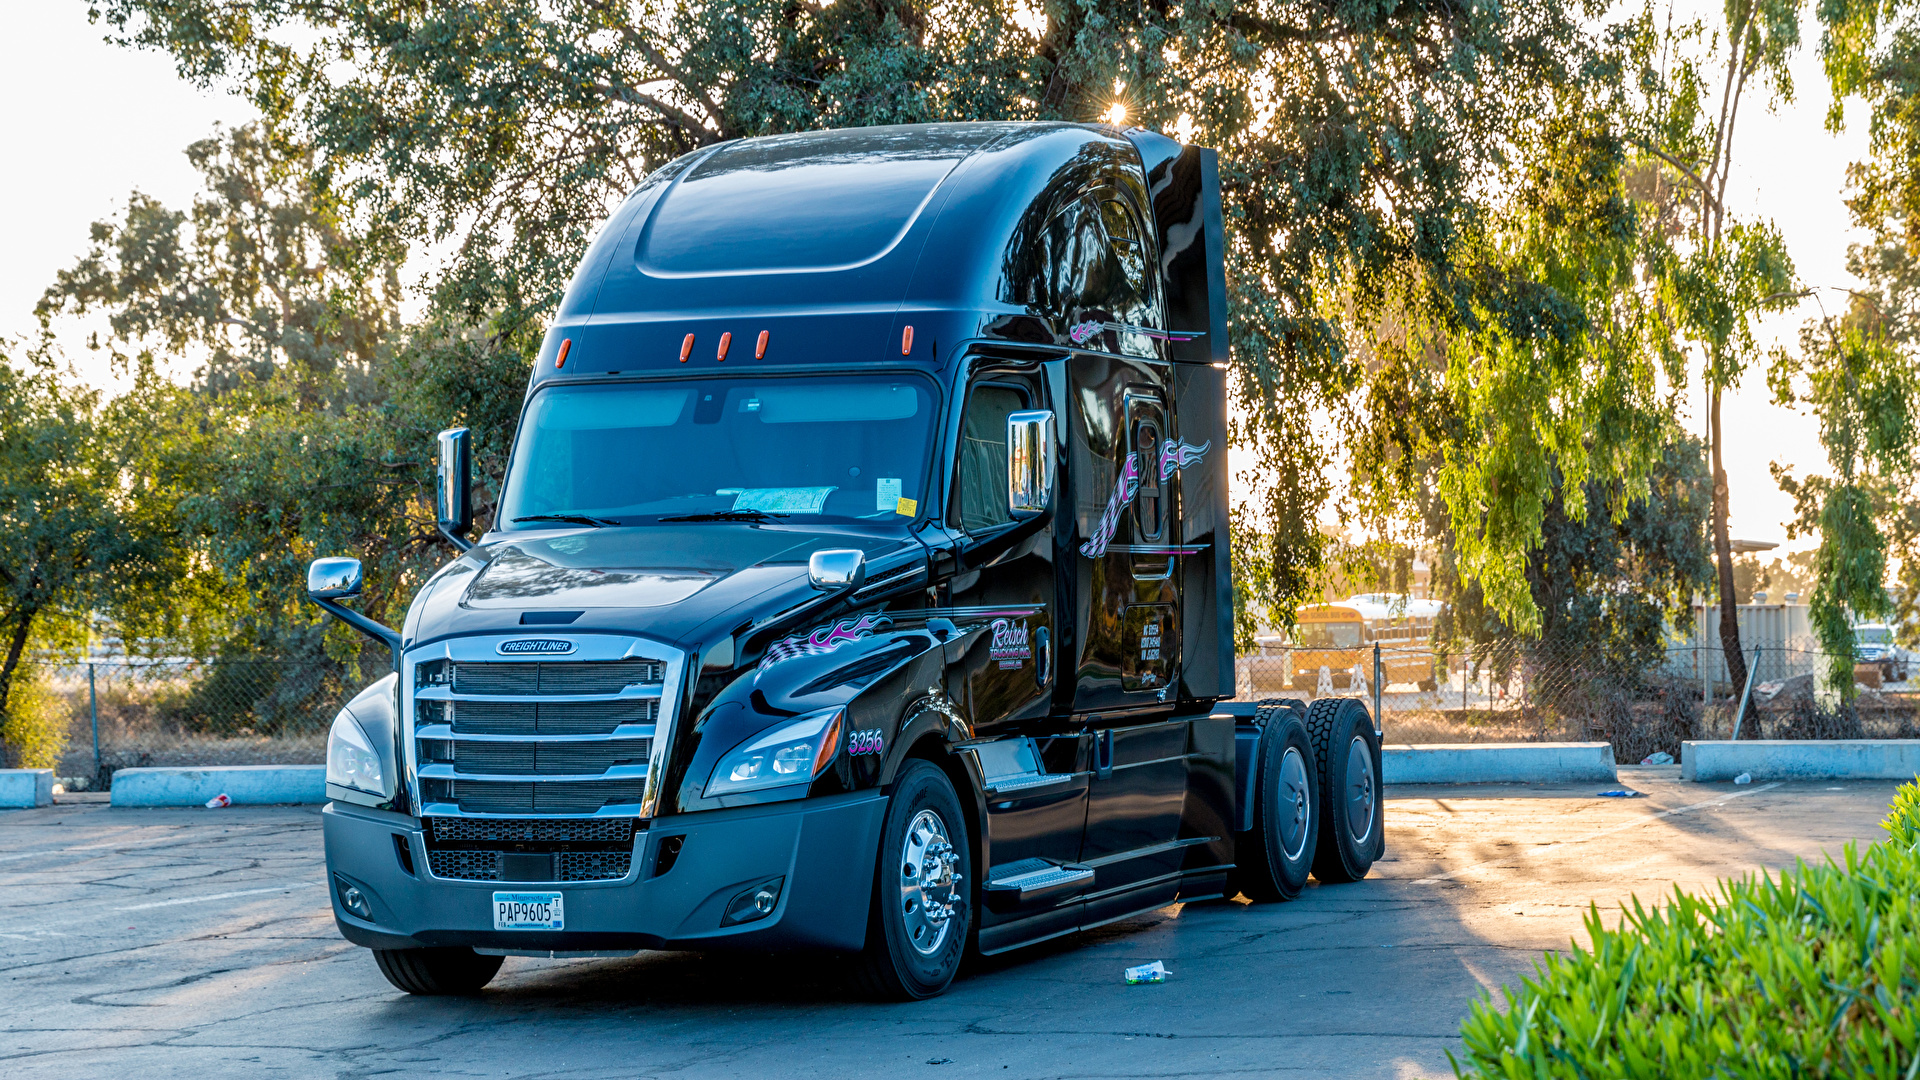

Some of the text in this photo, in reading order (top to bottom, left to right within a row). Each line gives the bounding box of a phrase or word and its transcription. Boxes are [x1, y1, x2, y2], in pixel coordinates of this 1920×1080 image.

[990, 618, 1029, 648] Reisch
[503, 641, 569, 651] FREIGHTLINER
[990, 647, 1019, 660] TRUCKING
[848, 728, 884, 756] 3256
[499, 903, 551, 921] PAP9605
